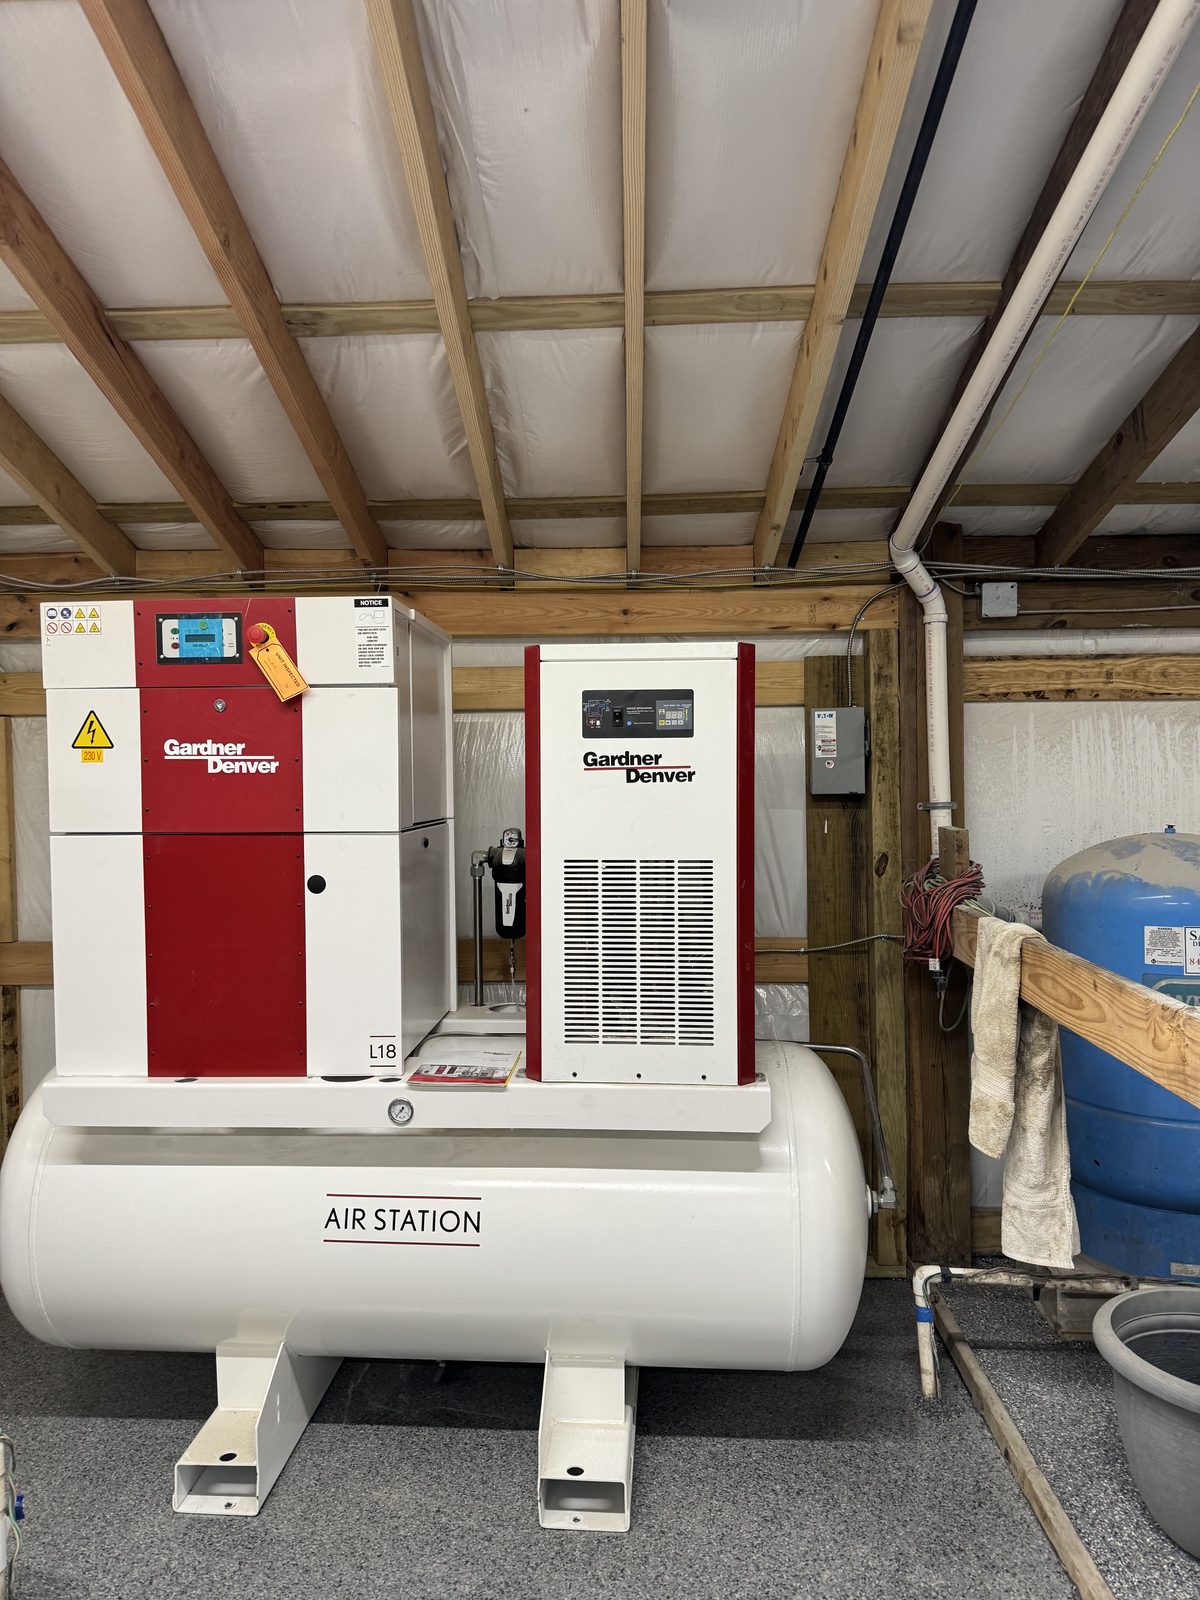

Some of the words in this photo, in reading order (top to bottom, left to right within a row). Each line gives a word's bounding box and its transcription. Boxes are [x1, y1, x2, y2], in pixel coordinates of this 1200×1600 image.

[275, 652, 284, 663] UNIT
[283, 663, 301, 688] INSPECTED
[164, 739, 246, 756] Gardner
[83, 751, 95, 760] 230
[96, 751, 102, 760] V
[583, 751, 662, 767] Gardner
[207, 759, 280, 774] Denver
[625, 768, 696, 783] Denver
[370, 1044, 397, 1059] L18
[324, 1207, 367, 1230] AIR
[374, 1208, 481, 1233] STATION
